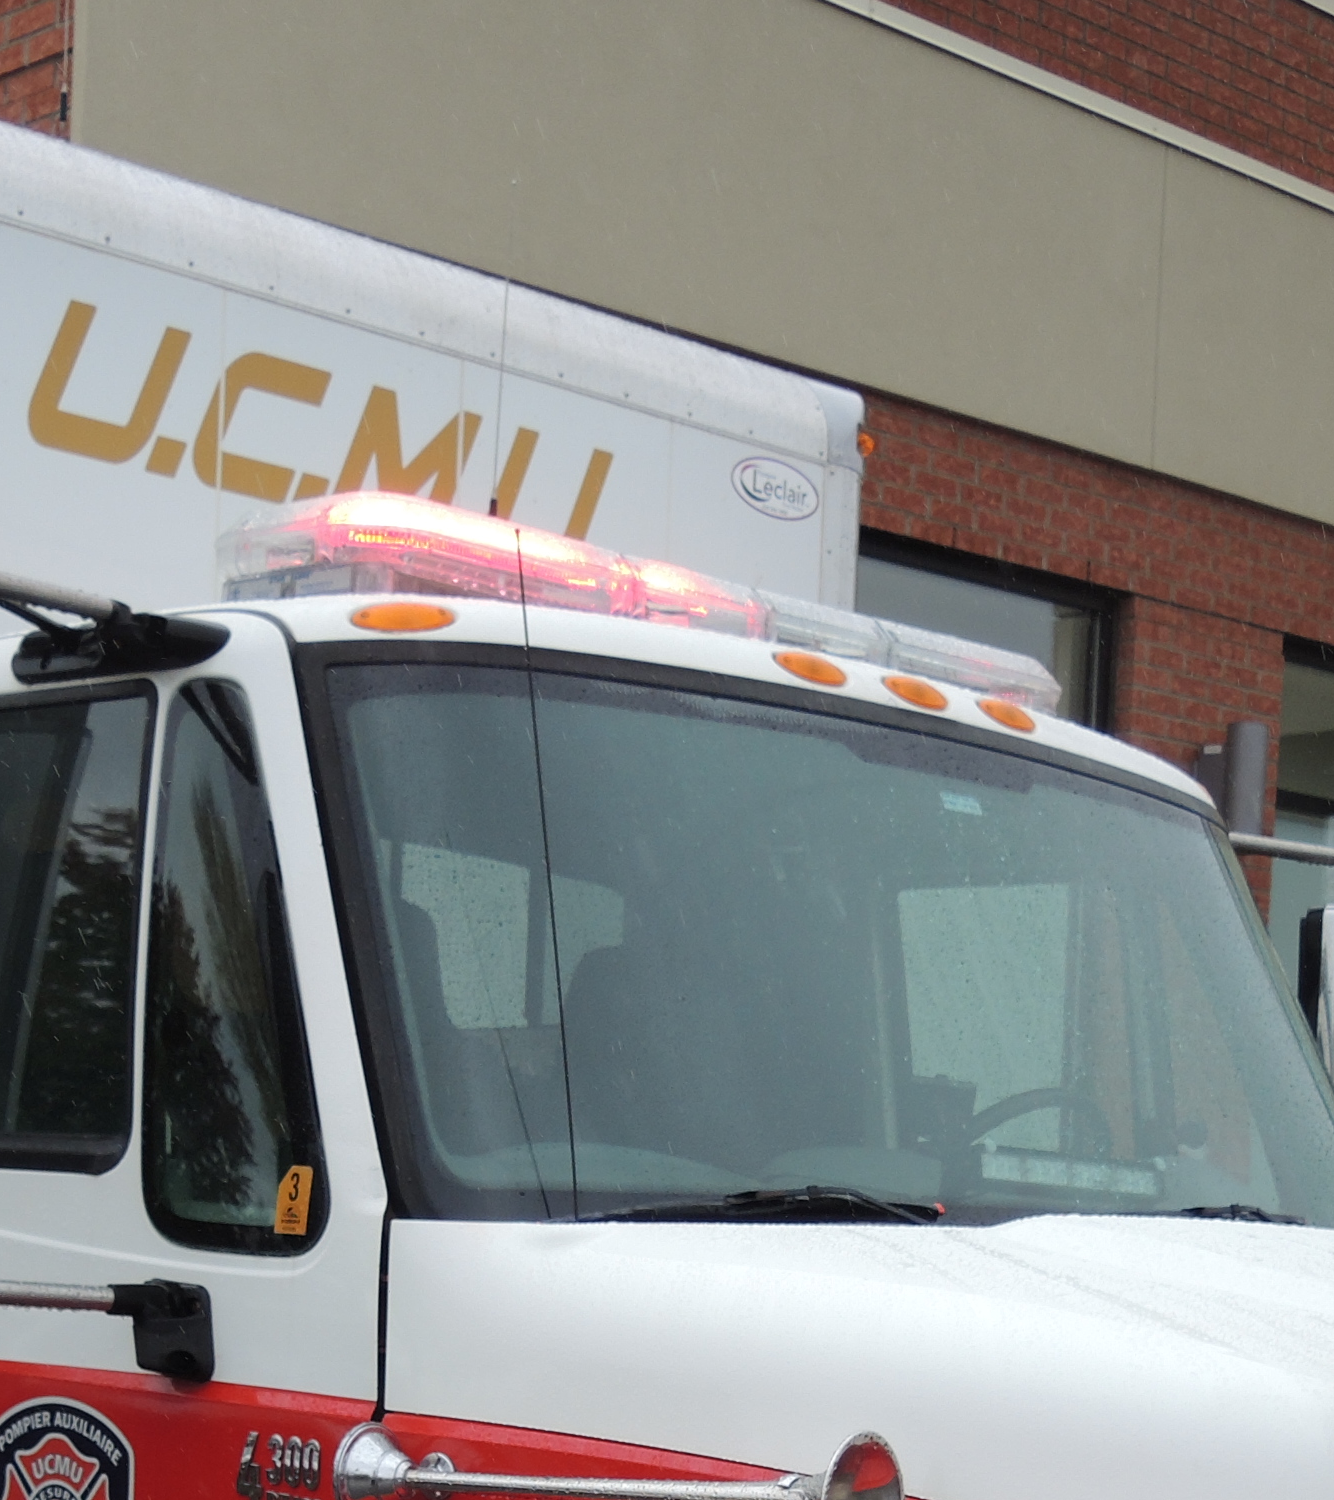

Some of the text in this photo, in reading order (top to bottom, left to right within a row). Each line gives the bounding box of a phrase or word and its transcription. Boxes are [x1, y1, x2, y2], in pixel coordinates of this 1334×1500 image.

[752, 468, 807, 507] Leclair
[288, 1172, 300, 1203] 3
[54, 1411, 123, 1467] AUXILIAIRE
[31, 1453, 84, 1484] UCMU
